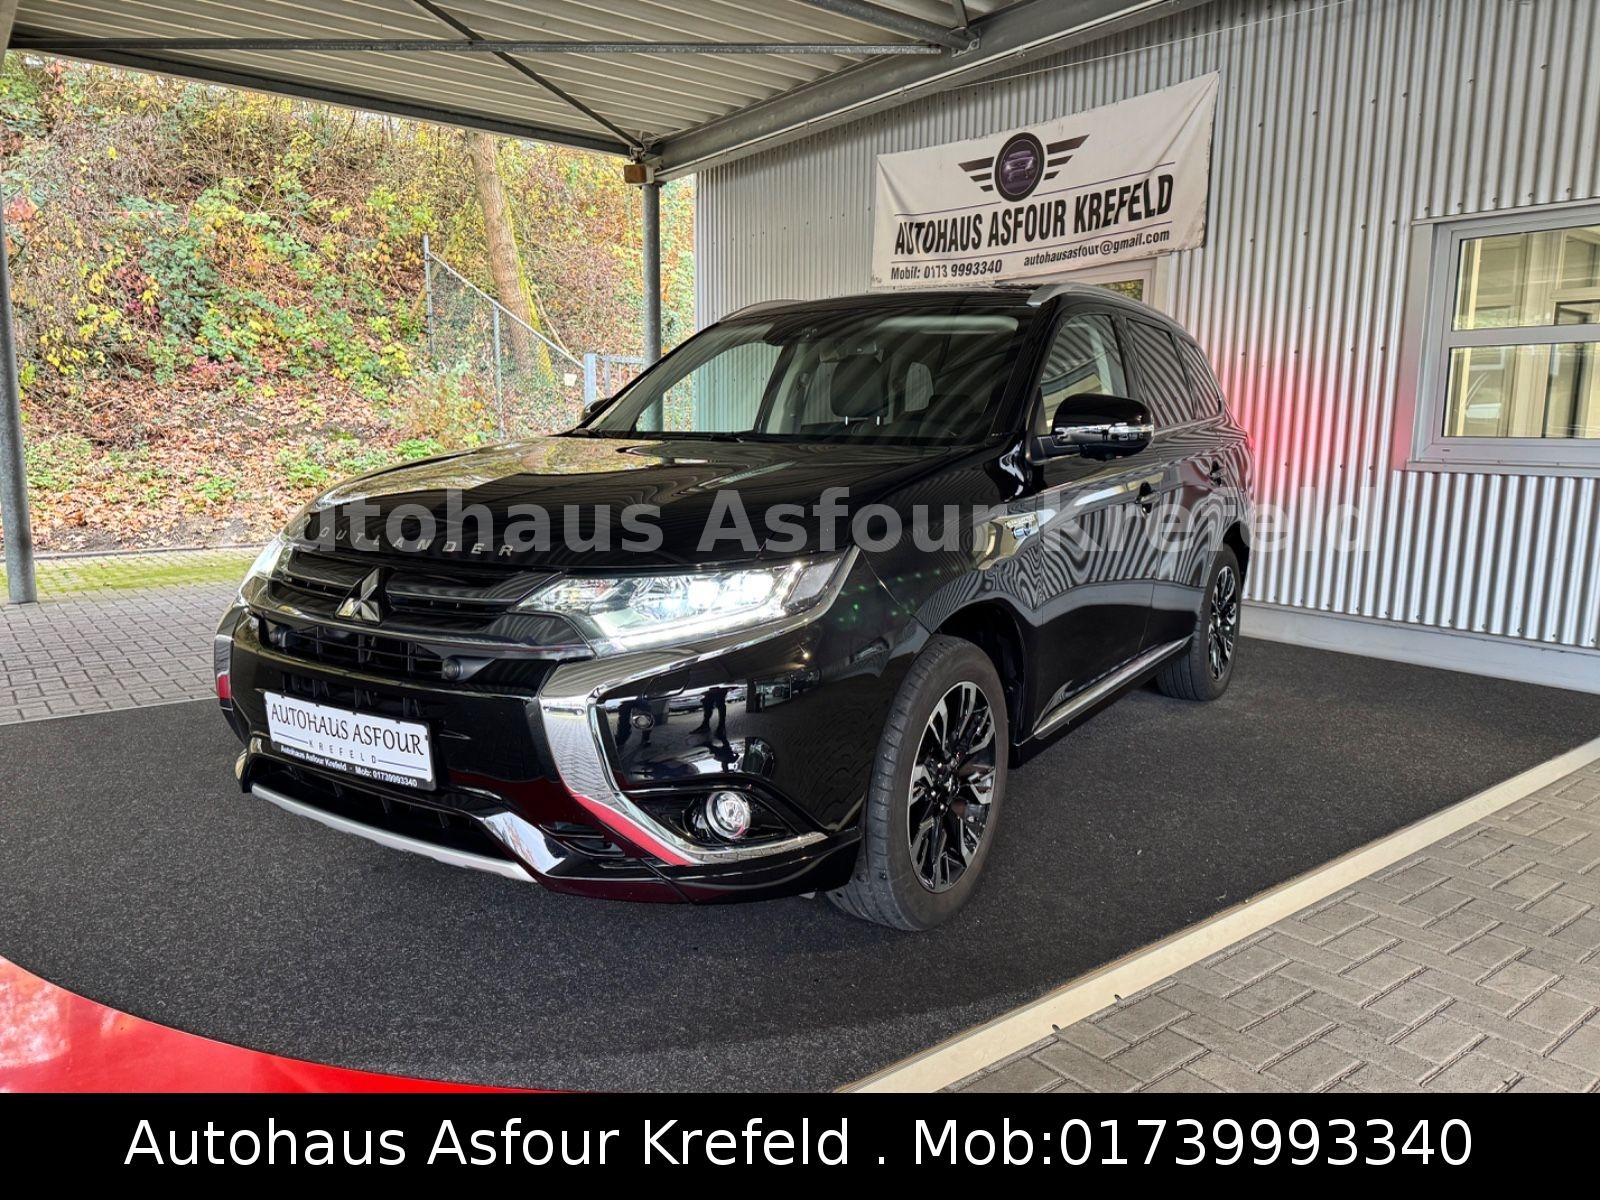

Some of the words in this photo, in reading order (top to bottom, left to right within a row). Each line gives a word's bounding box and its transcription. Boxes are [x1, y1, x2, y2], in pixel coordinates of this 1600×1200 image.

[894, 213, 983, 255] AUTOHAUS
[987, 198, 1067, 247] ASFOUR
[1074, 174, 1174, 234] KREFELD
[1023, 229, 1170, 267] autohausasfour@gmail.com
[890, 265, 921, 280] Mobil:
[923, 265, 948, 279] 0173
[950, 259, 1003, 277] 9993340
[318, 525, 515, 557] OUTLANDER
[271, 703, 349, 739] AUTOHAUS
[352, 723, 424, 756] ASFOUR
[308, 738, 376, 764] KREFELD
